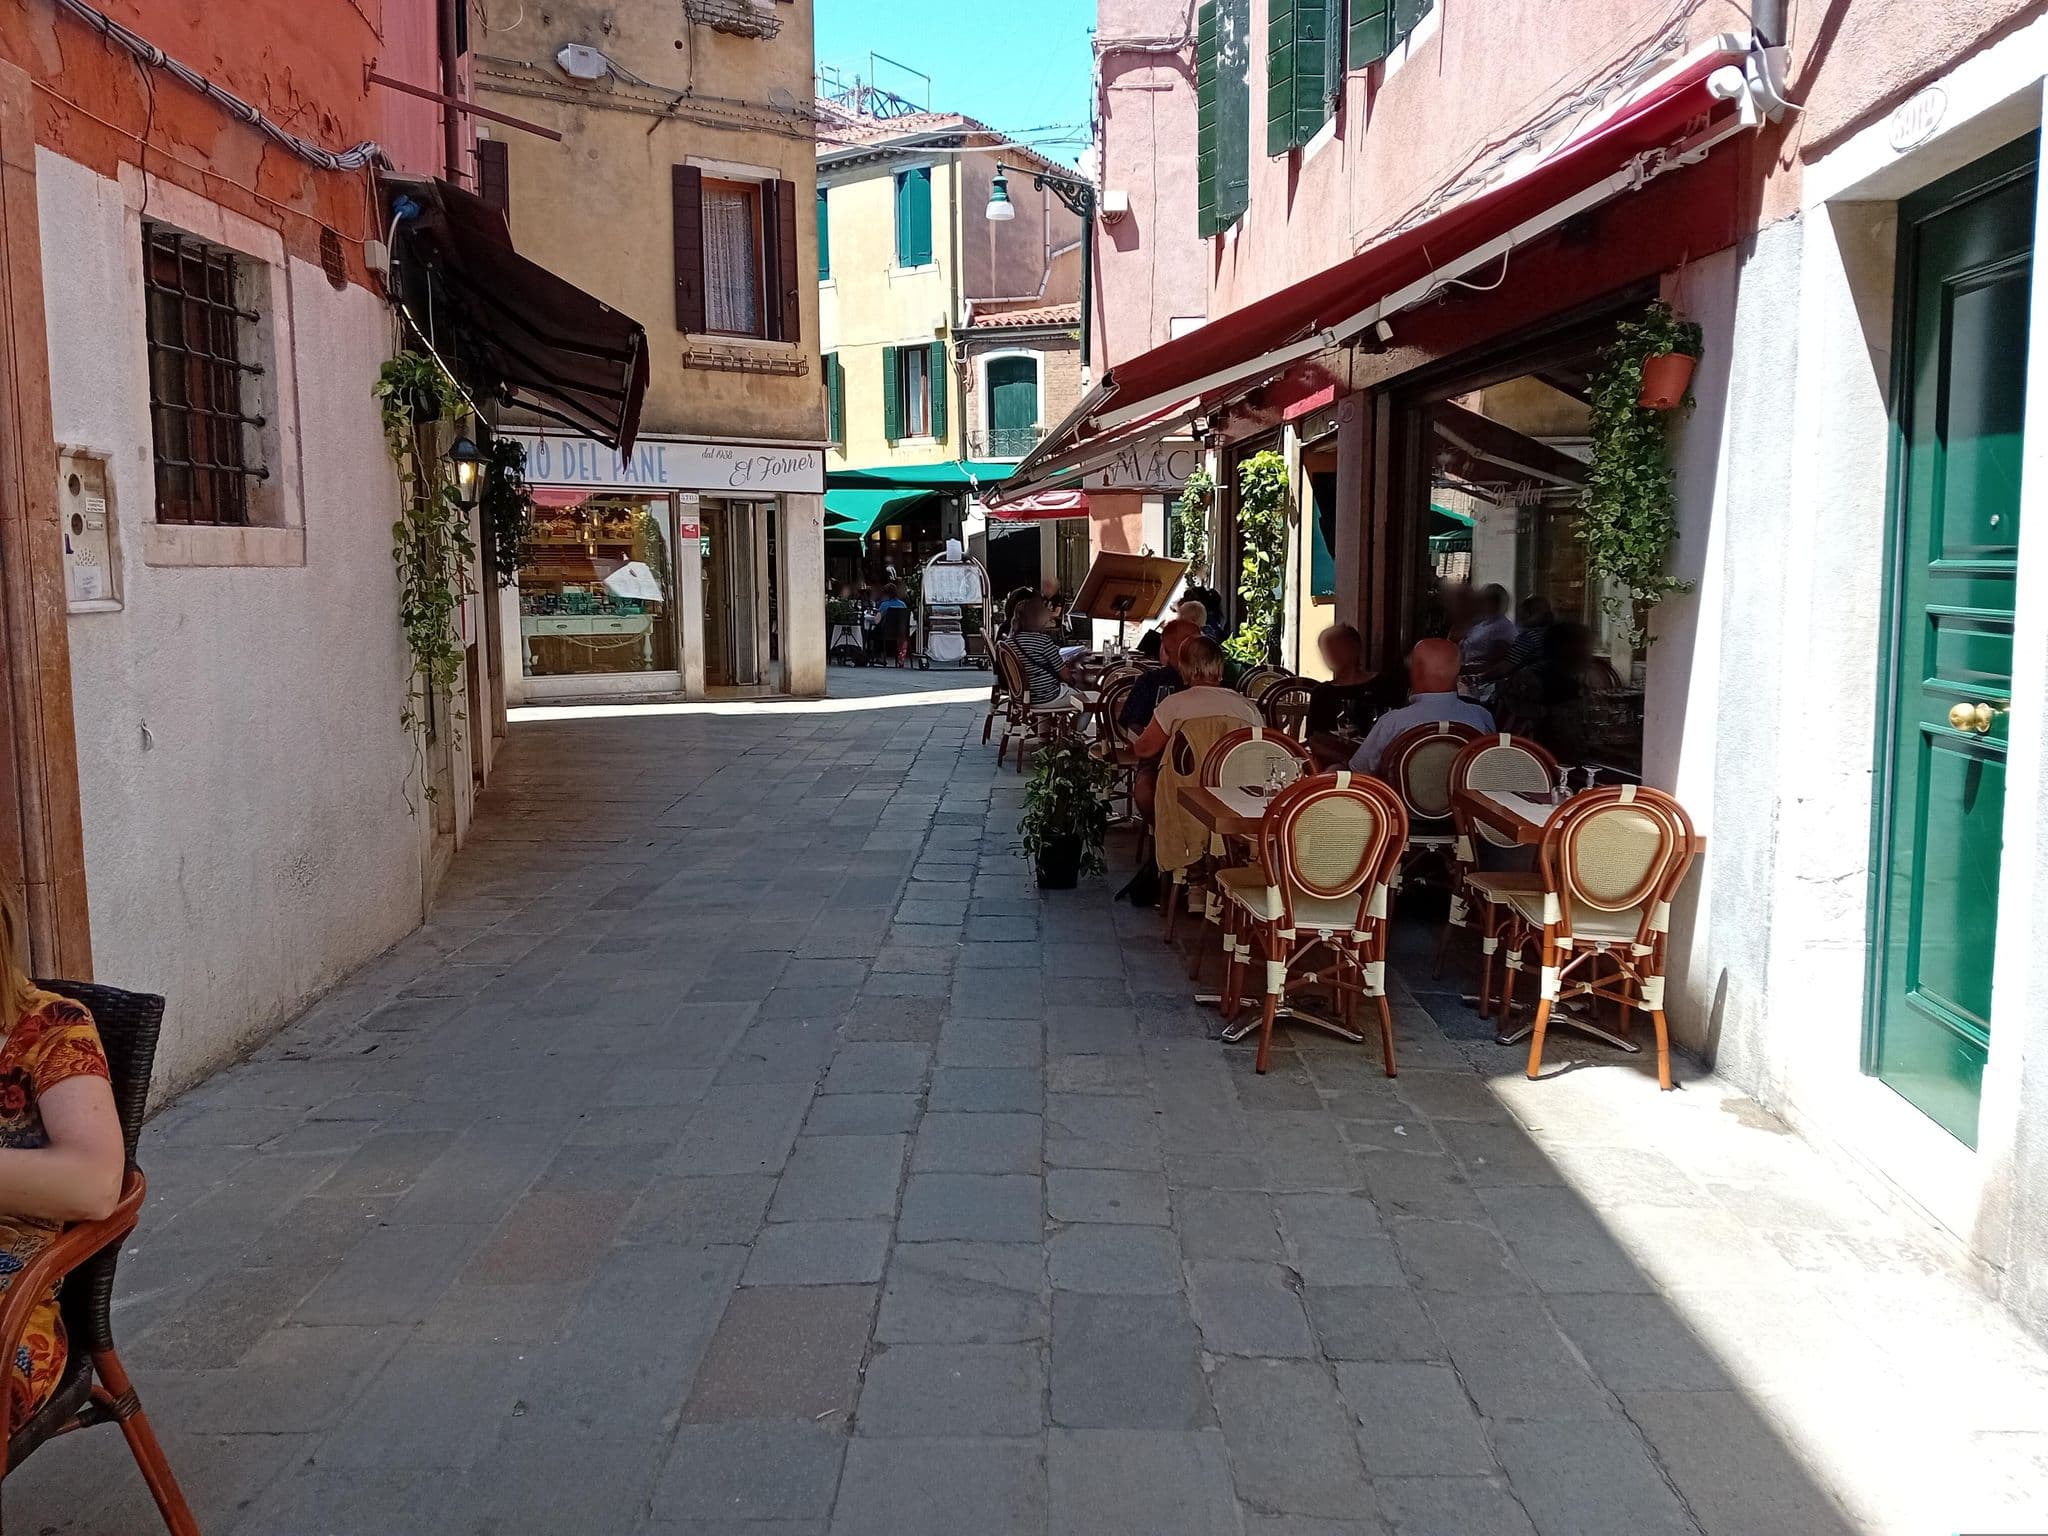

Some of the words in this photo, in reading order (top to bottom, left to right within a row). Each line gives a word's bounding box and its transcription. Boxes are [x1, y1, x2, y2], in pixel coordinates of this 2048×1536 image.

[562, 441, 602, 481] DEL
[612, 444, 668, 483] PANE
[729, 458, 753, 487] El
[757, 453, 816, 482] Forner
